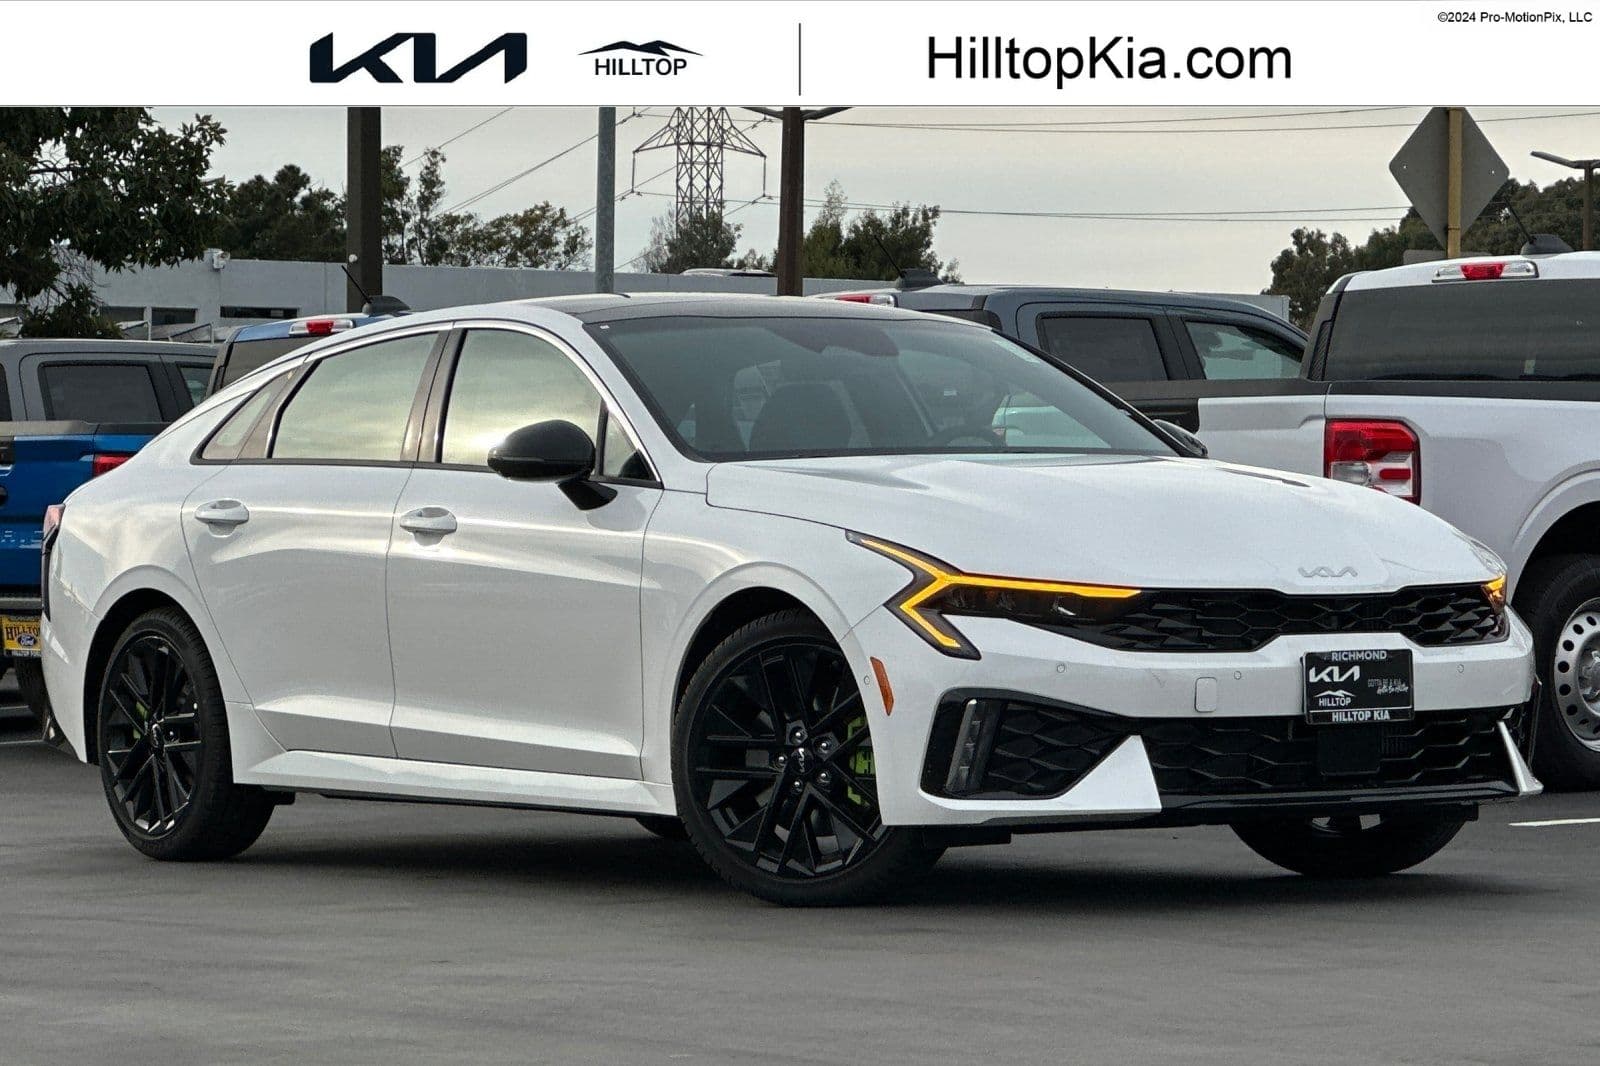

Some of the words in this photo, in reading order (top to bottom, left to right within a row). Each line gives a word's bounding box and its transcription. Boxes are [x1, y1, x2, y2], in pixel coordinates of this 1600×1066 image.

[5, 625, 41, 641] HILLTO
[1331, 650, 1388, 662] RICHMOND
[1318, 697, 1351, 707] HILLTOP
[1331, 711, 1372, 722] HILLTOP
[1373, 710, 1391, 720] KIA
